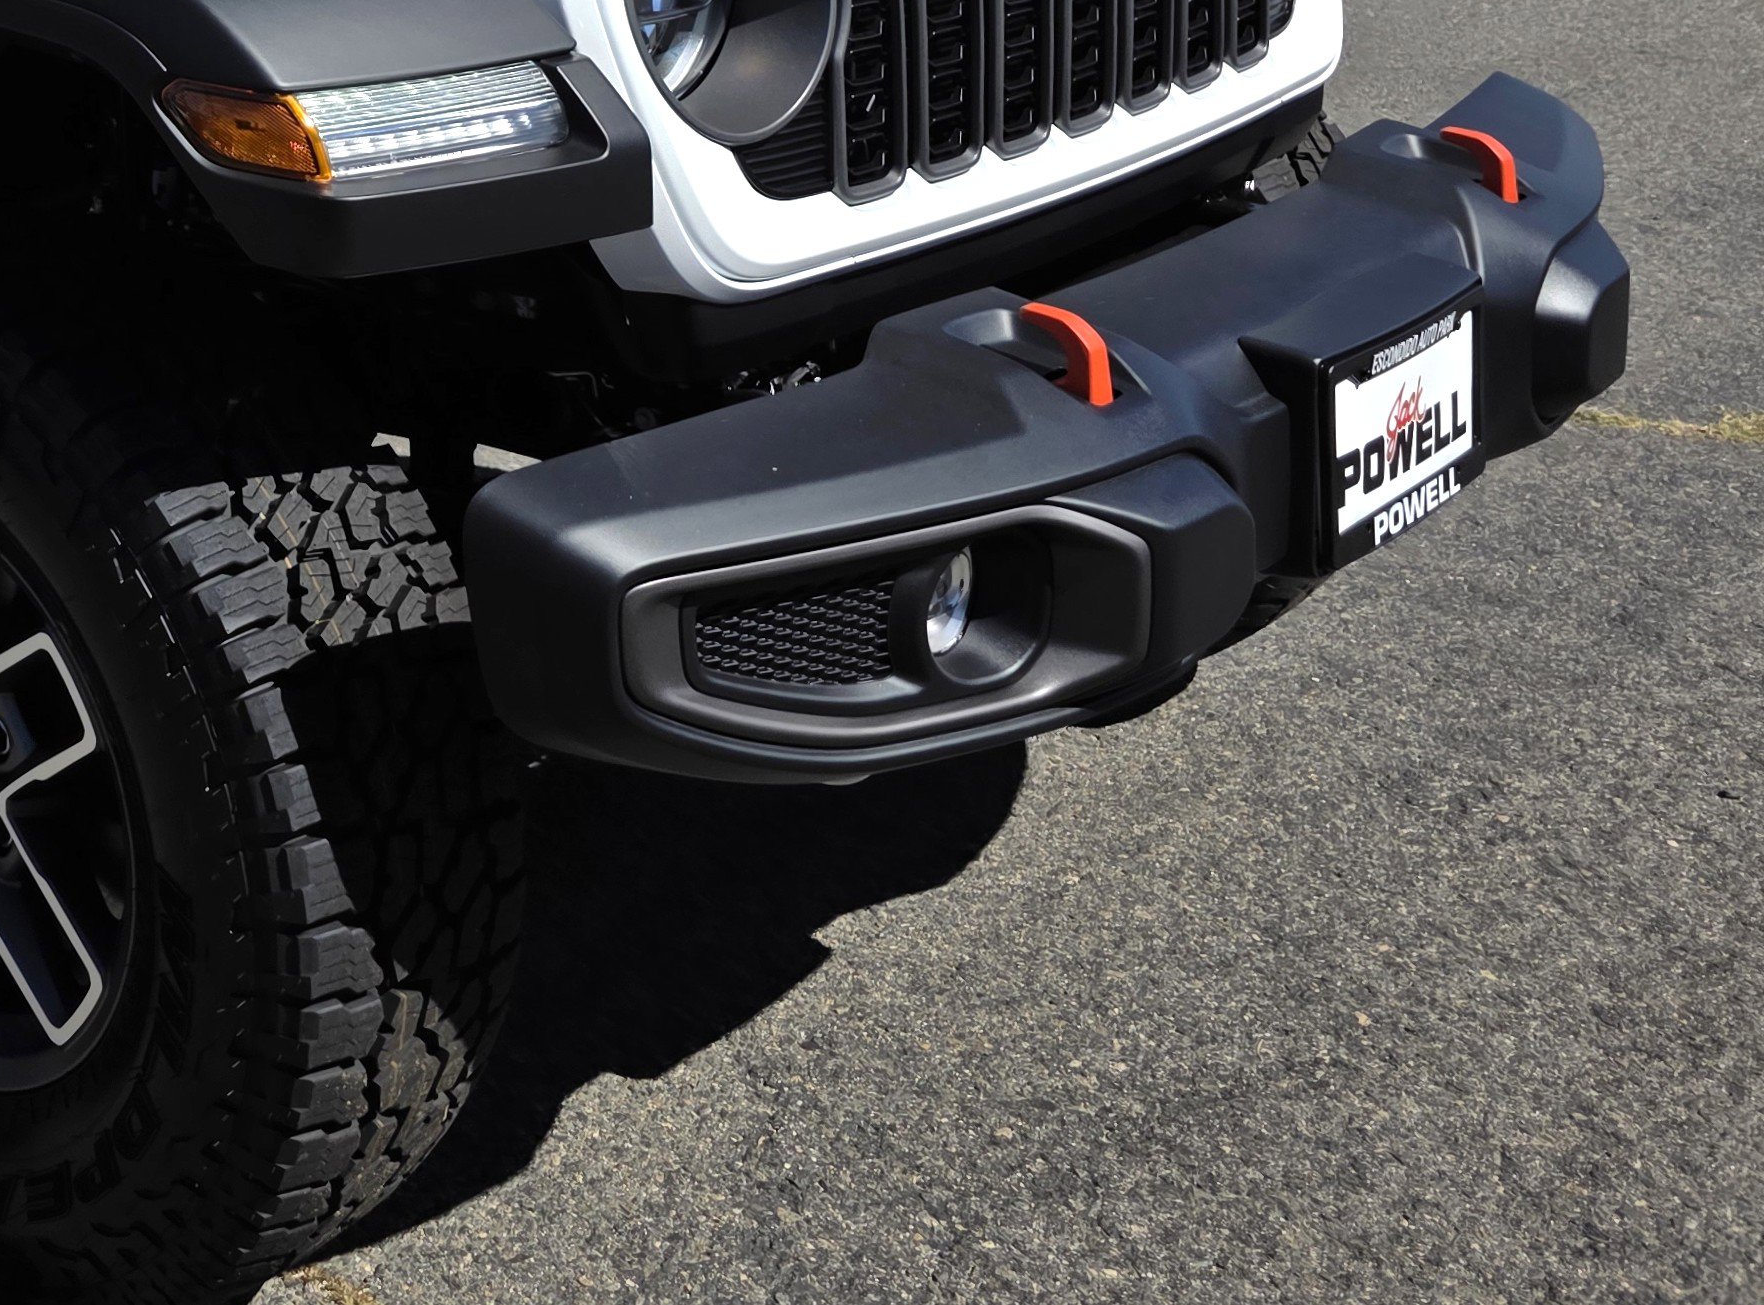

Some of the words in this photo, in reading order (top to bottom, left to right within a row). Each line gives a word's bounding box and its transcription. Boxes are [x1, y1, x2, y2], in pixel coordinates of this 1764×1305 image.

[1371, 334, 1419, 376] ESCONDIDO
[1416, 322, 1439, 353] AUTO
[1436, 310, 1457, 341] PARK
[1335, 390, 1467, 511] POWELL
[1386, 374, 1426, 464] Jack
[1373, 465, 1461, 547] POWELL
